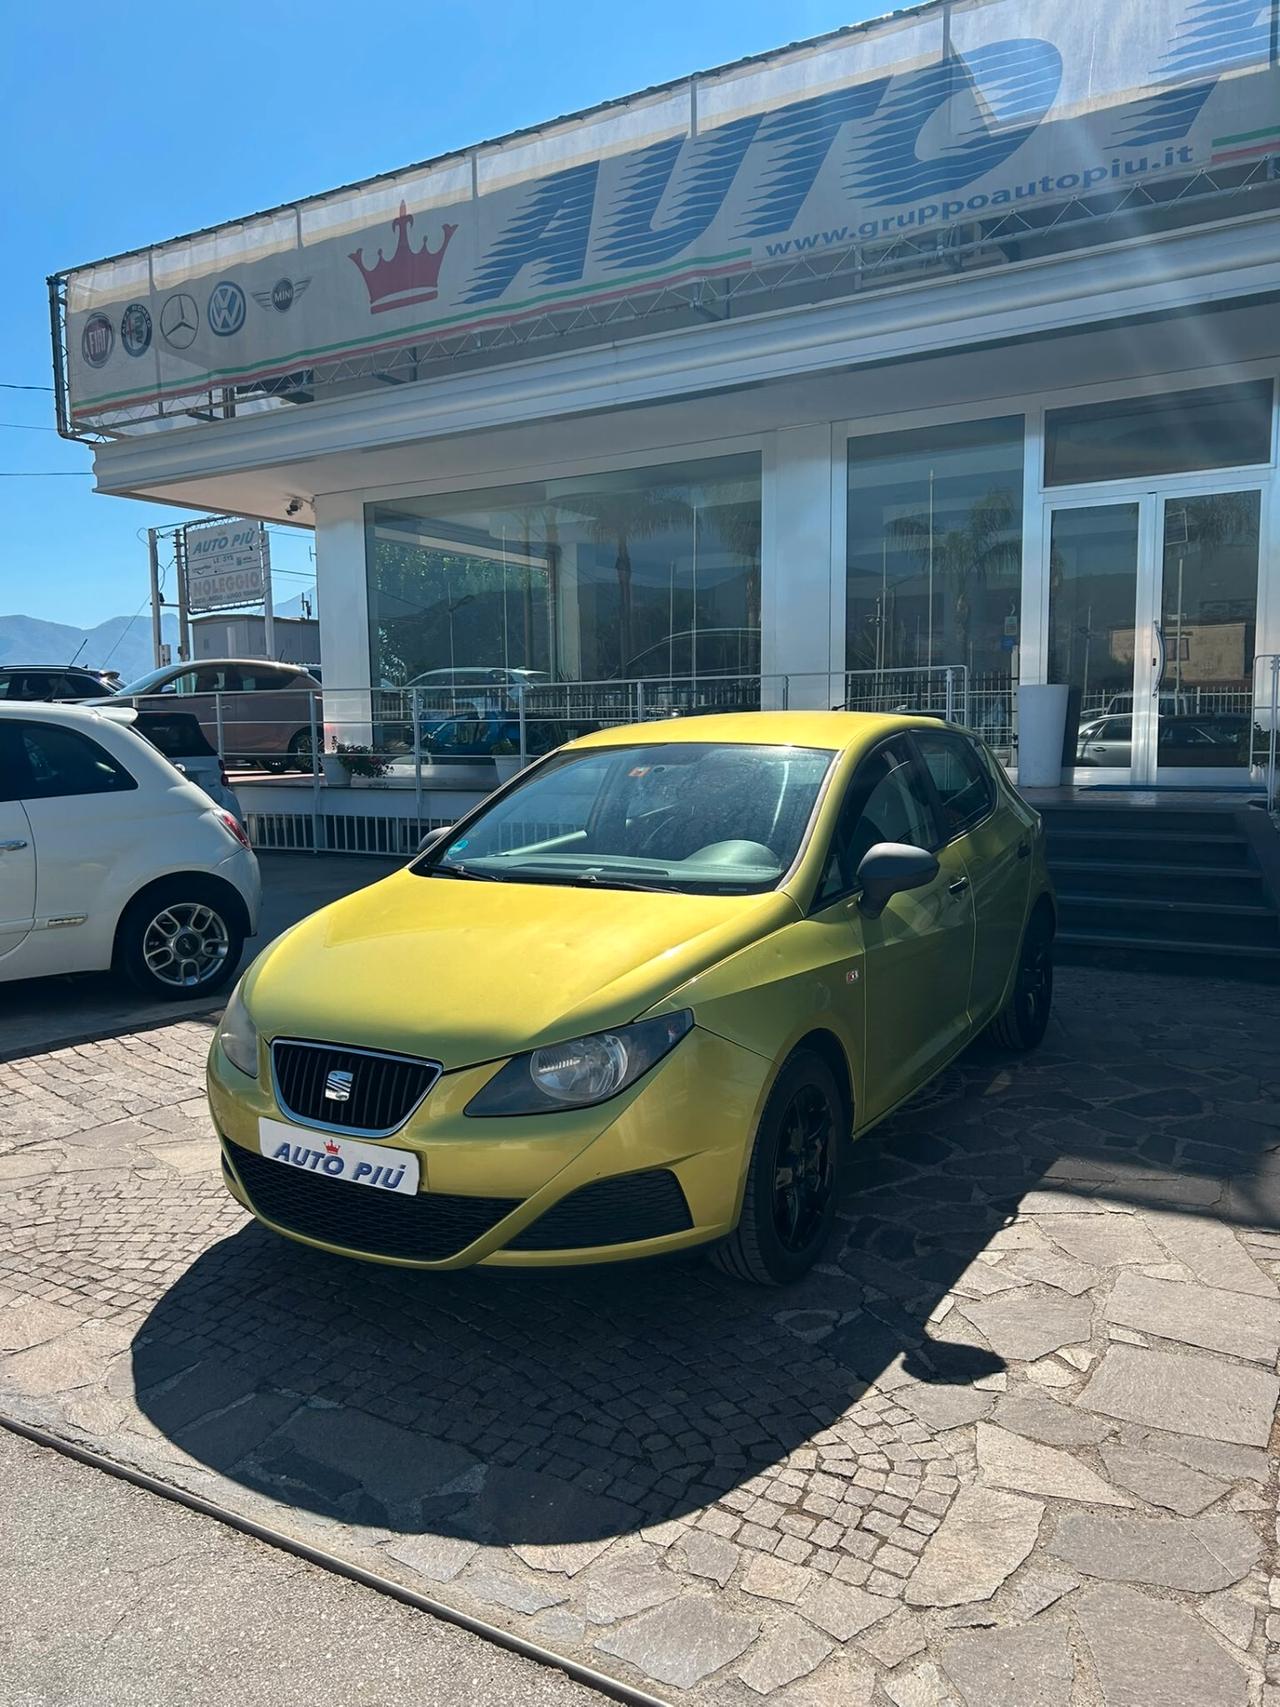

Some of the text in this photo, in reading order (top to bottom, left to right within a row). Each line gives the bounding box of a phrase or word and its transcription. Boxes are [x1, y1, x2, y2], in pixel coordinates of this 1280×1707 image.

[455, 37, 1063, 304] AUTO
[766, 144, 1193, 257] www.gruppoautopiu.it
[273, 288, 294, 304] MINI
[192, 536, 229, 555] AUTO
[193, 571, 260, 597] NOLEGGIO
[273, 1142, 345, 1176] AUTO
